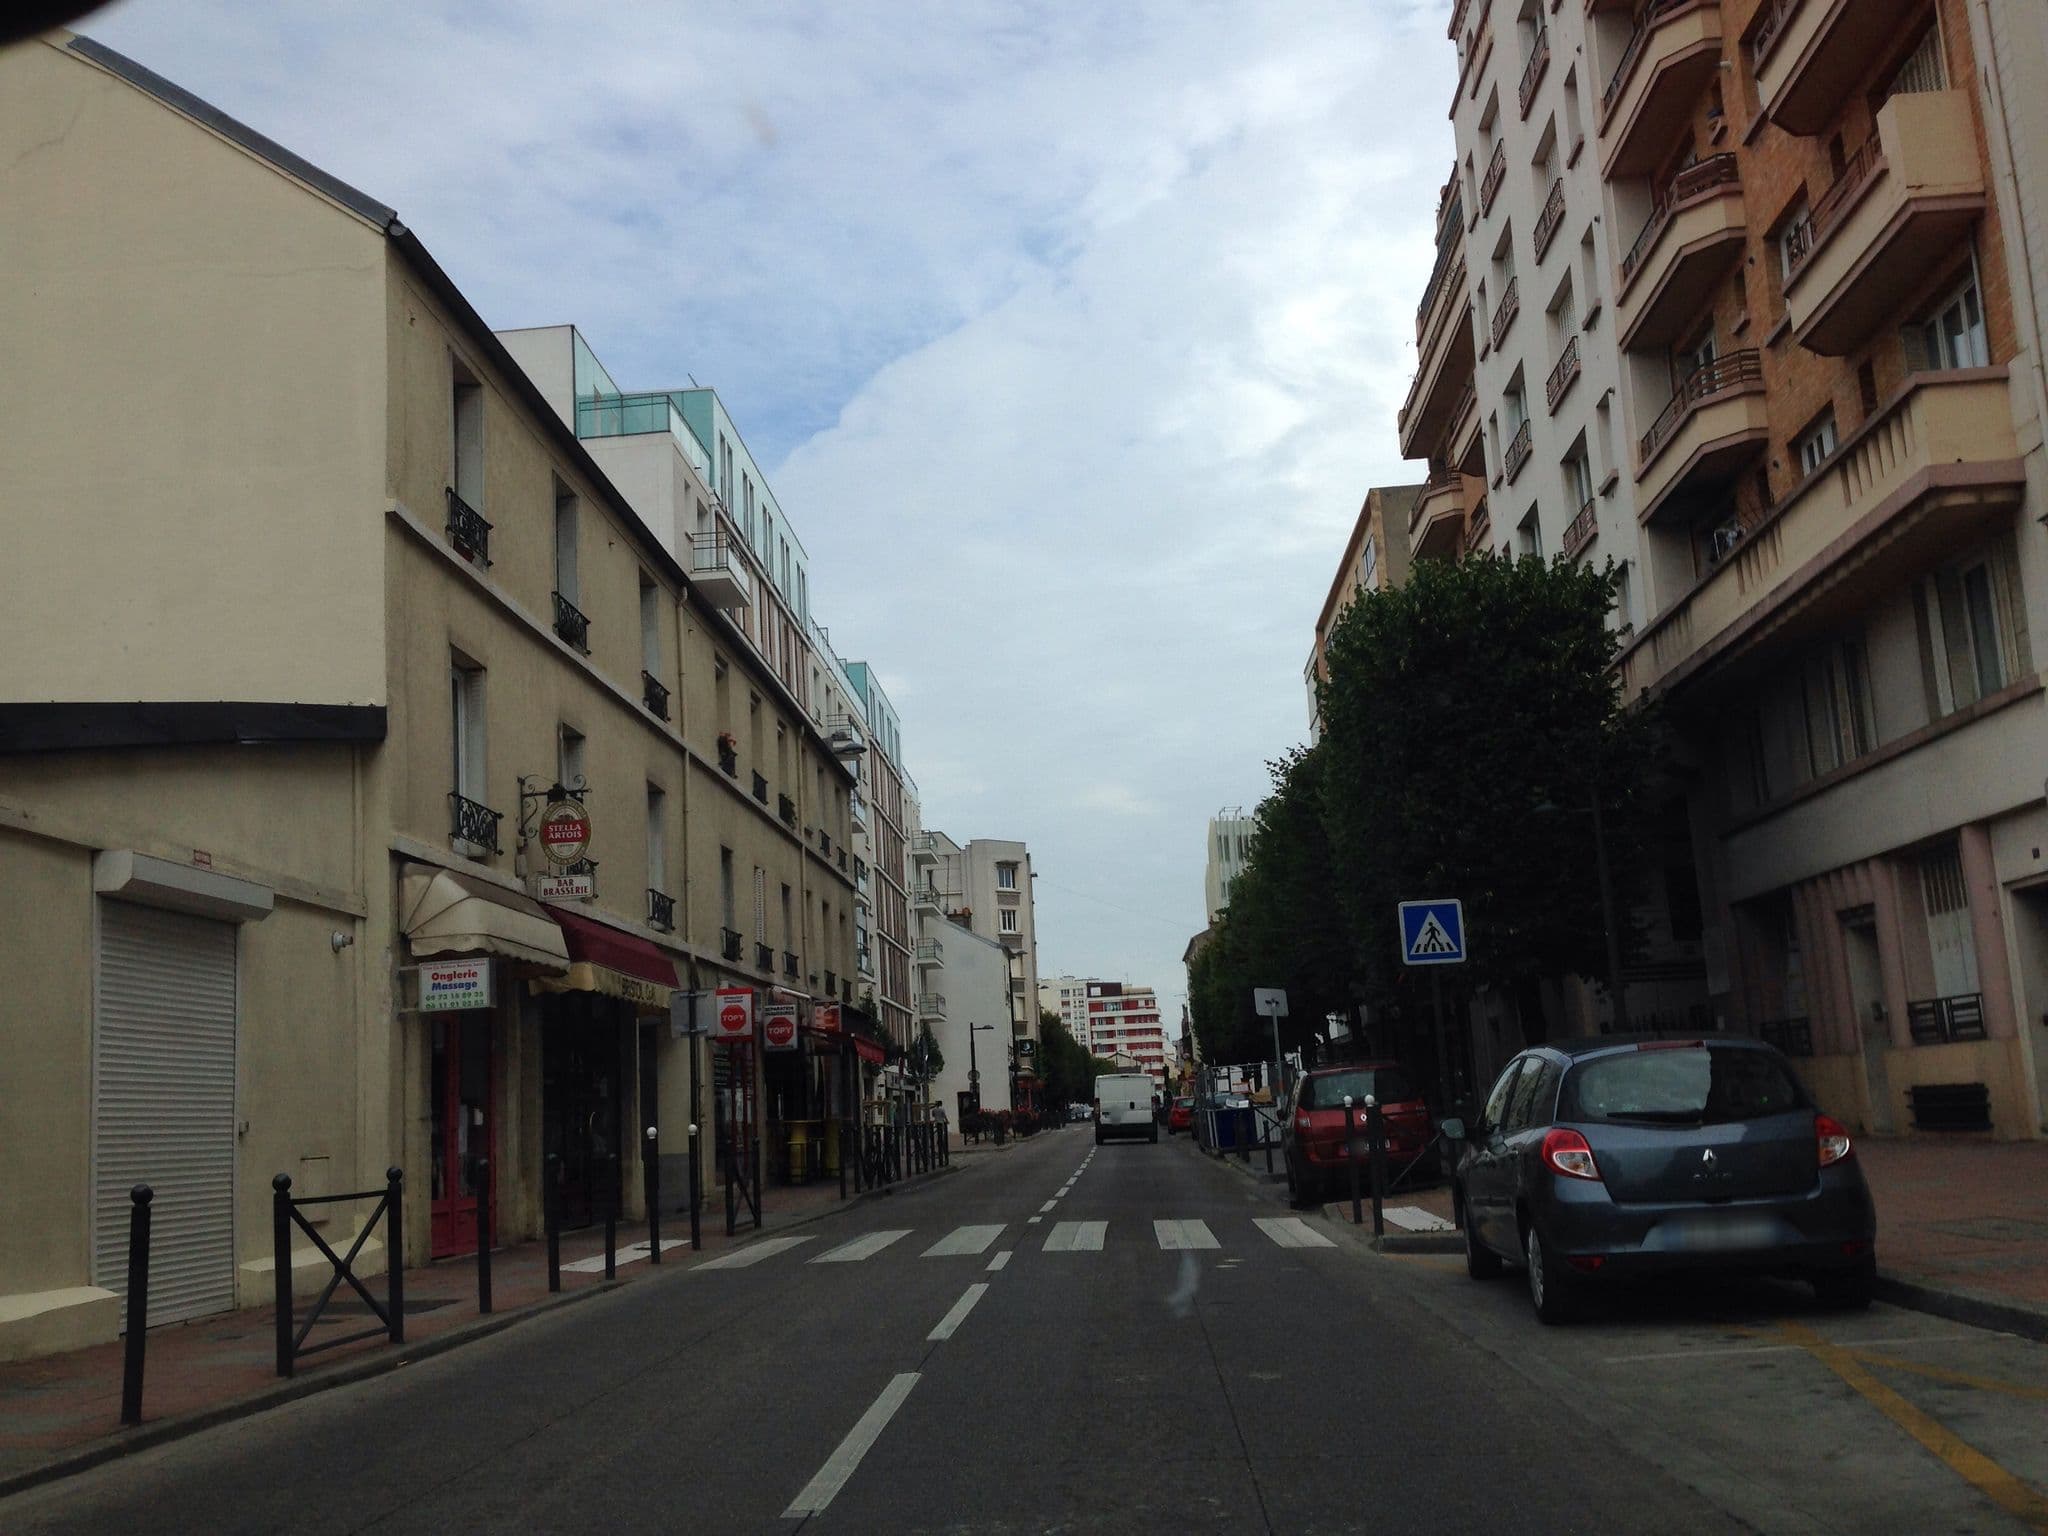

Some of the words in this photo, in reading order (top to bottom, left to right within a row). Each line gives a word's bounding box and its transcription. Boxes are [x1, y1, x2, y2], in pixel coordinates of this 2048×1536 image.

[549, 824, 581, 832] STELLA
[549, 831, 582, 839] ARTOIS
[557, 879, 574, 887] BAR
[543, 886, 588, 896] BRASSERIE
[431, 969, 478, 982] Onglerie
[431, 981, 478, 991] Massage
[722, 1014, 745, 1022] TOPY
